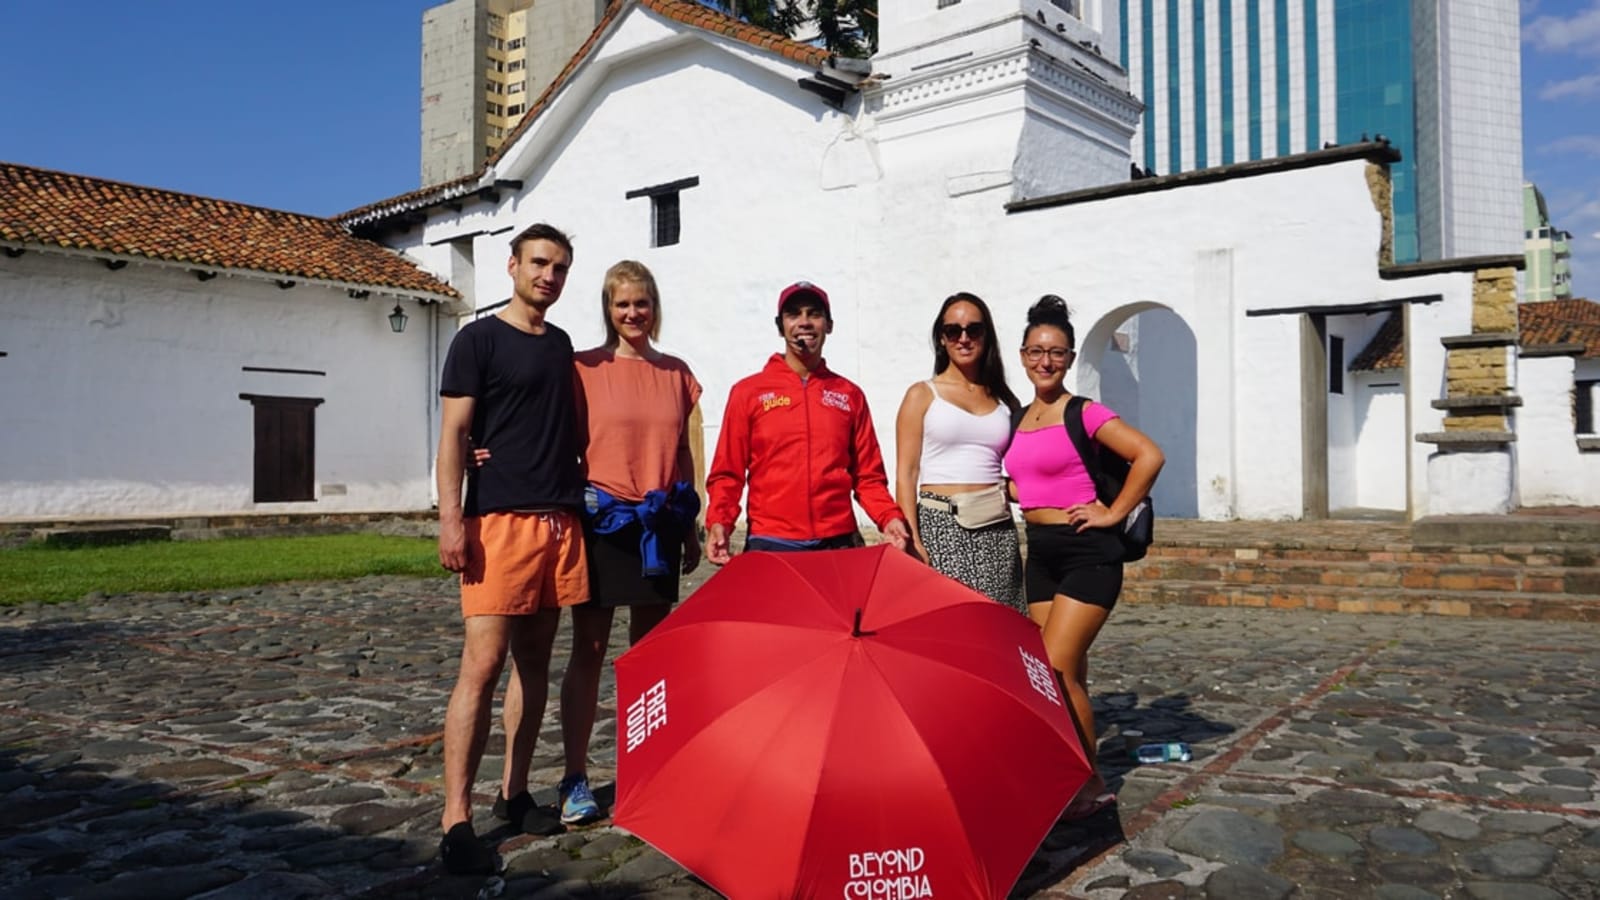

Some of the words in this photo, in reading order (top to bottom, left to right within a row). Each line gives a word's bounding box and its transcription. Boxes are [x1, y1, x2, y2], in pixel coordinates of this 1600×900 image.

[763, 395, 791, 411] guide
[1018, 646, 1046, 696] FREE
[1034, 657, 1061, 706] TOUR
[626, 692, 646, 753] TOUR
[646, 679, 667, 737] FREE
[849, 847, 924, 878] BEYOND
[844, 875, 933, 900] COLOMBIA
